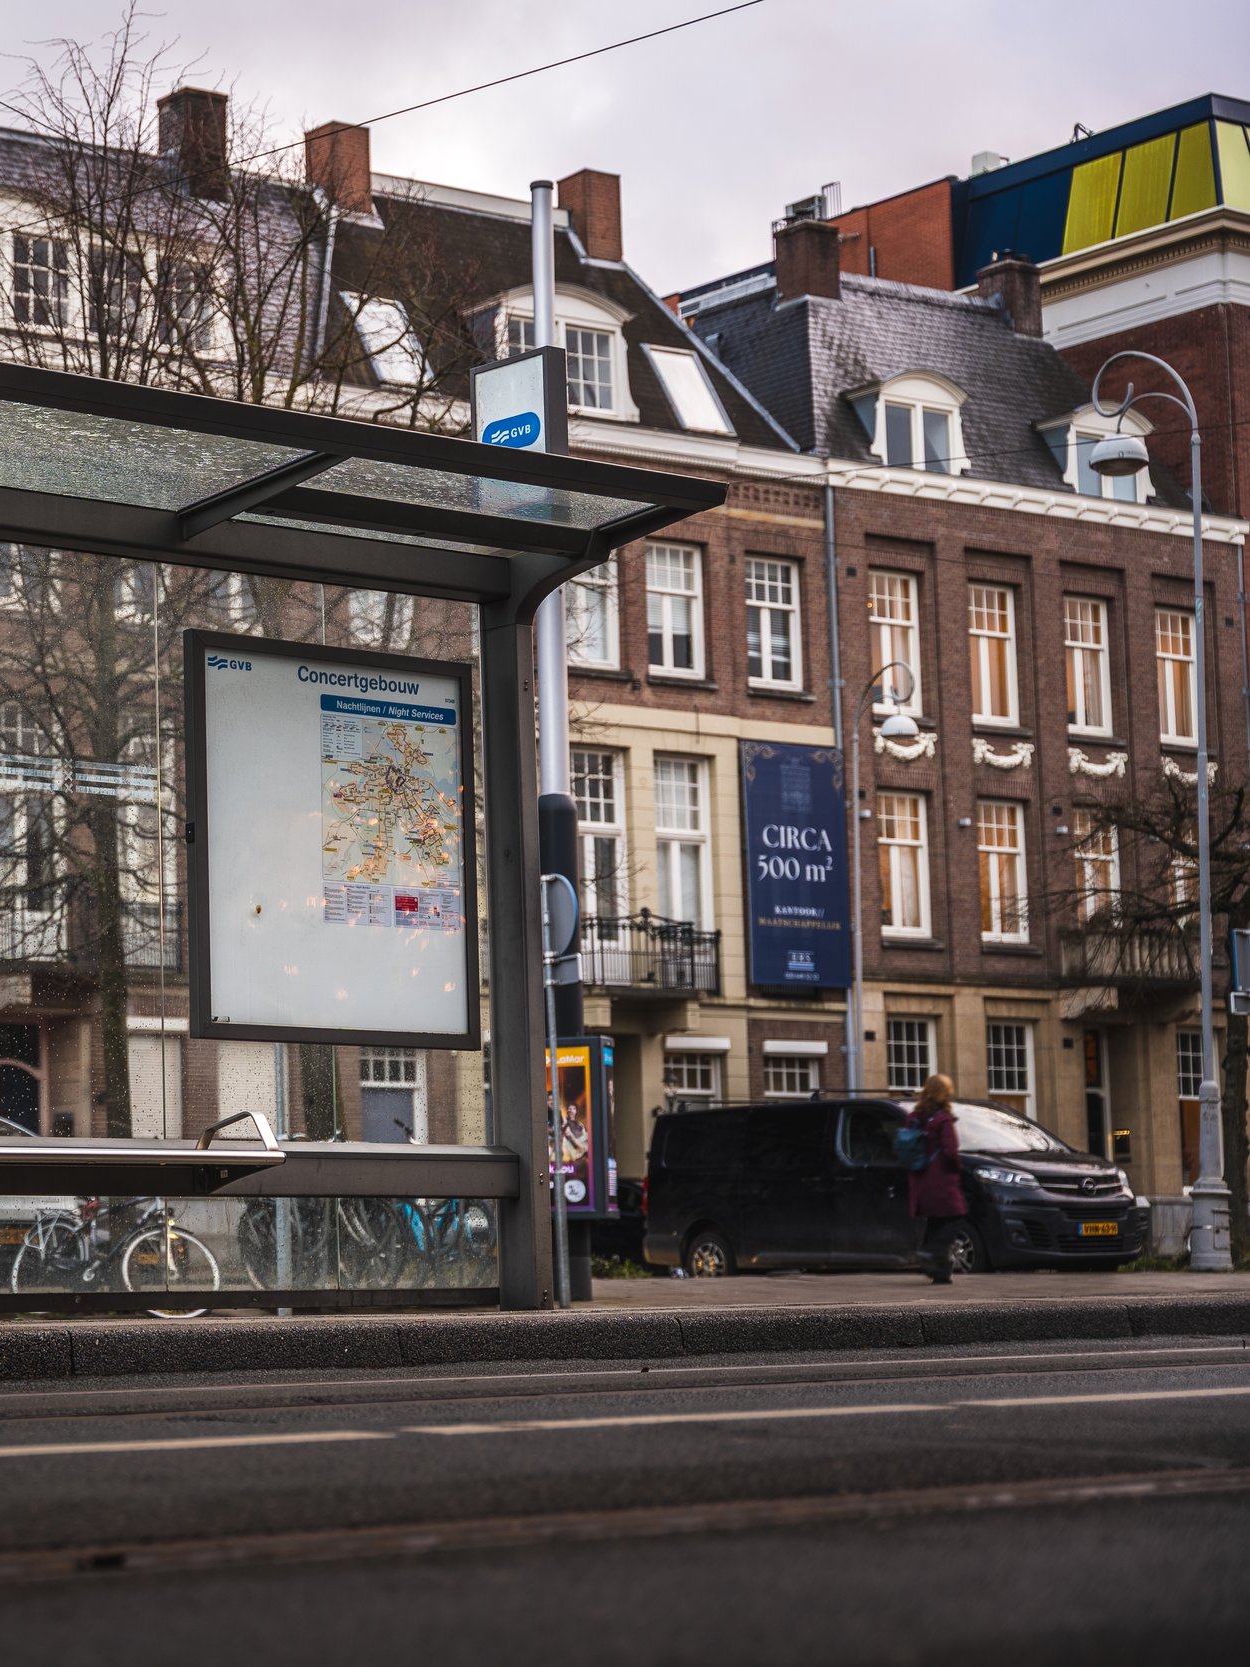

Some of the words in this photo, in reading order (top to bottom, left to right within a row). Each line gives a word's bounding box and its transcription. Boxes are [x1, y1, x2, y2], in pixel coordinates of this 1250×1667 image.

[510, 424, 531, 438] GVB
[229, 659, 252, 672] GVB
[297, 665, 420, 695] Concertgebouw
[336, 700, 381, 714] Nachtlijnen
[388, 706, 410, 718] Night
[411, 708, 444, 721] Services
[762, 824, 833, 852] CIRCA
[758, 855, 800, 881] 500
